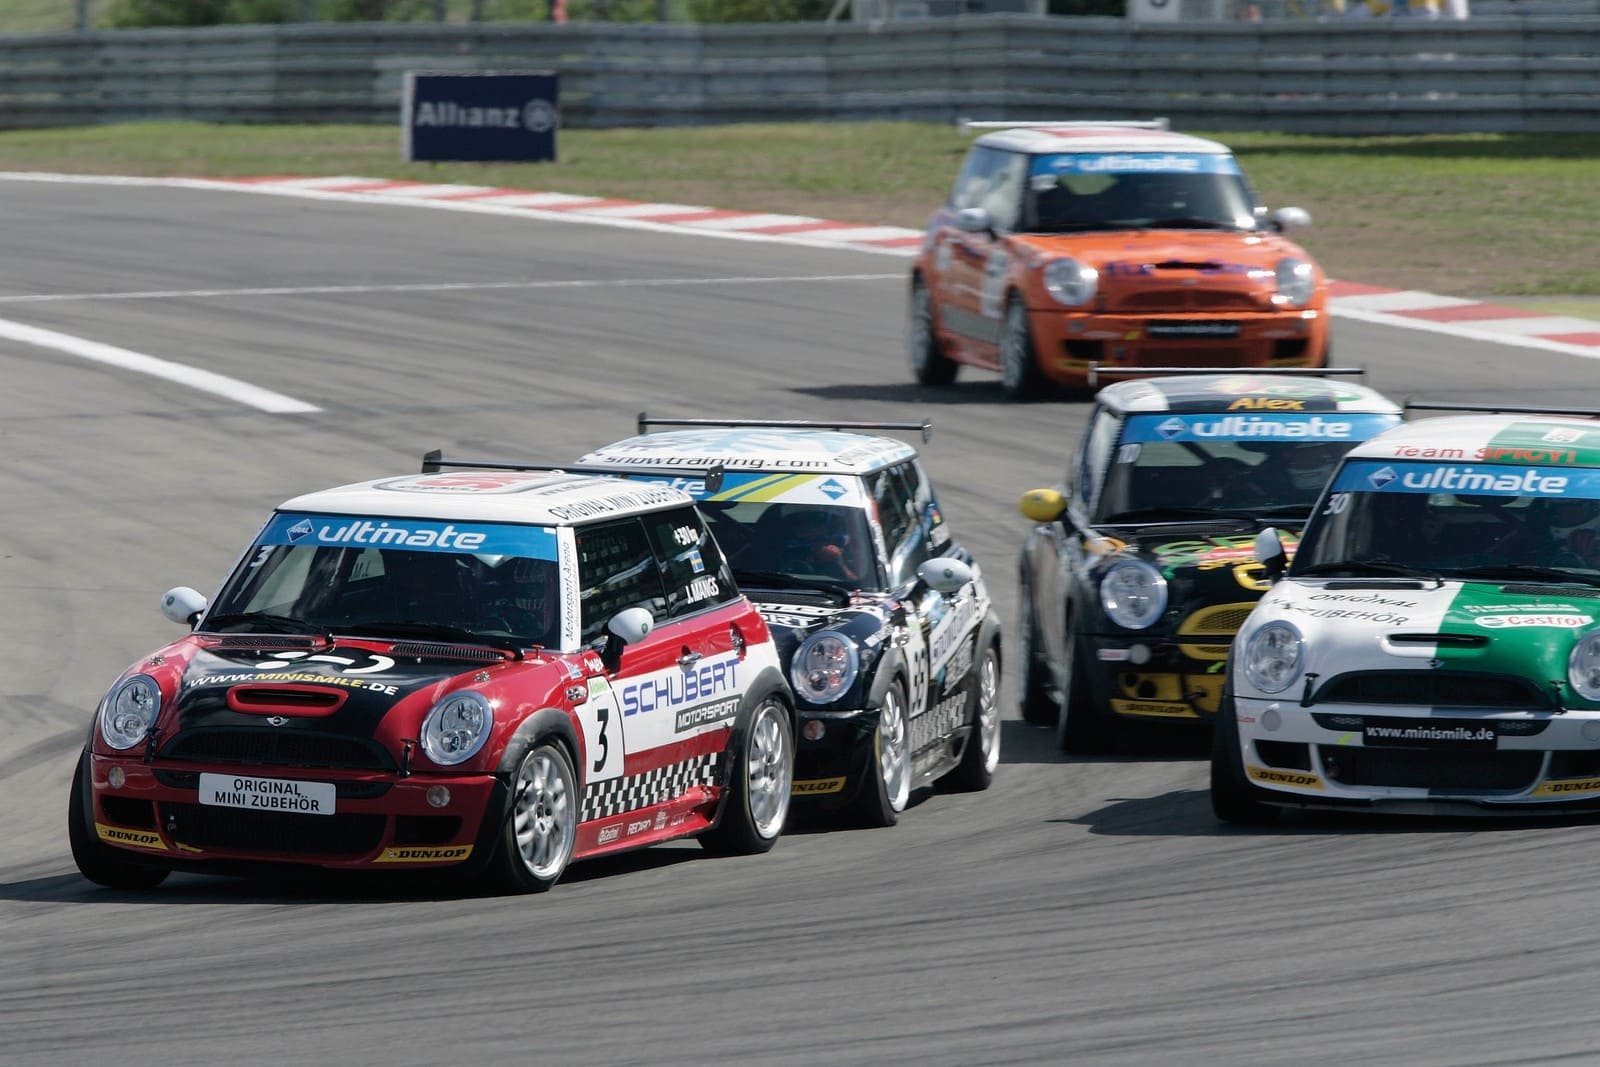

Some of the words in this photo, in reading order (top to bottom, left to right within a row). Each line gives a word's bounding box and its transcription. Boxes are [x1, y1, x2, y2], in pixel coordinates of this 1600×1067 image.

[416, 101, 520, 127] Allianz
[1227, 397, 1306, 411] Alex
[1191, 415, 1353, 438] ultimate
[604, 454, 828, 470] snowtraining.com
[1394, 445, 1464, 459] Team
[1402, 467, 1569, 493] ultimate
[548, 496, 614, 521] ORIGINAL
[1323, 493, 1350, 516] 30
[317, 520, 487, 550] ultimate
[1309, 593, 1417, 608] ORIGINAL
[1507, 616, 1586, 626] Castrol
[623, 658, 741, 717] SCHUBERT
[677, 698, 741, 728] MOTORSPORT
[593, 708, 609, 773] 3
[1366, 726, 1495, 741] www.minismile.de
[233, 778, 302, 798] ORIGINAL
[1259, 771, 1317, 785] DUNLOP
[1552, 781, 1600, 792] DUNLO
[215, 791, 246, 806] MINI
[251, 794, 320, 812] ZUBEHÖR
[108, 829, 159, 844] DUNLOP
[398, 849, 467, 859] DUNLOP
